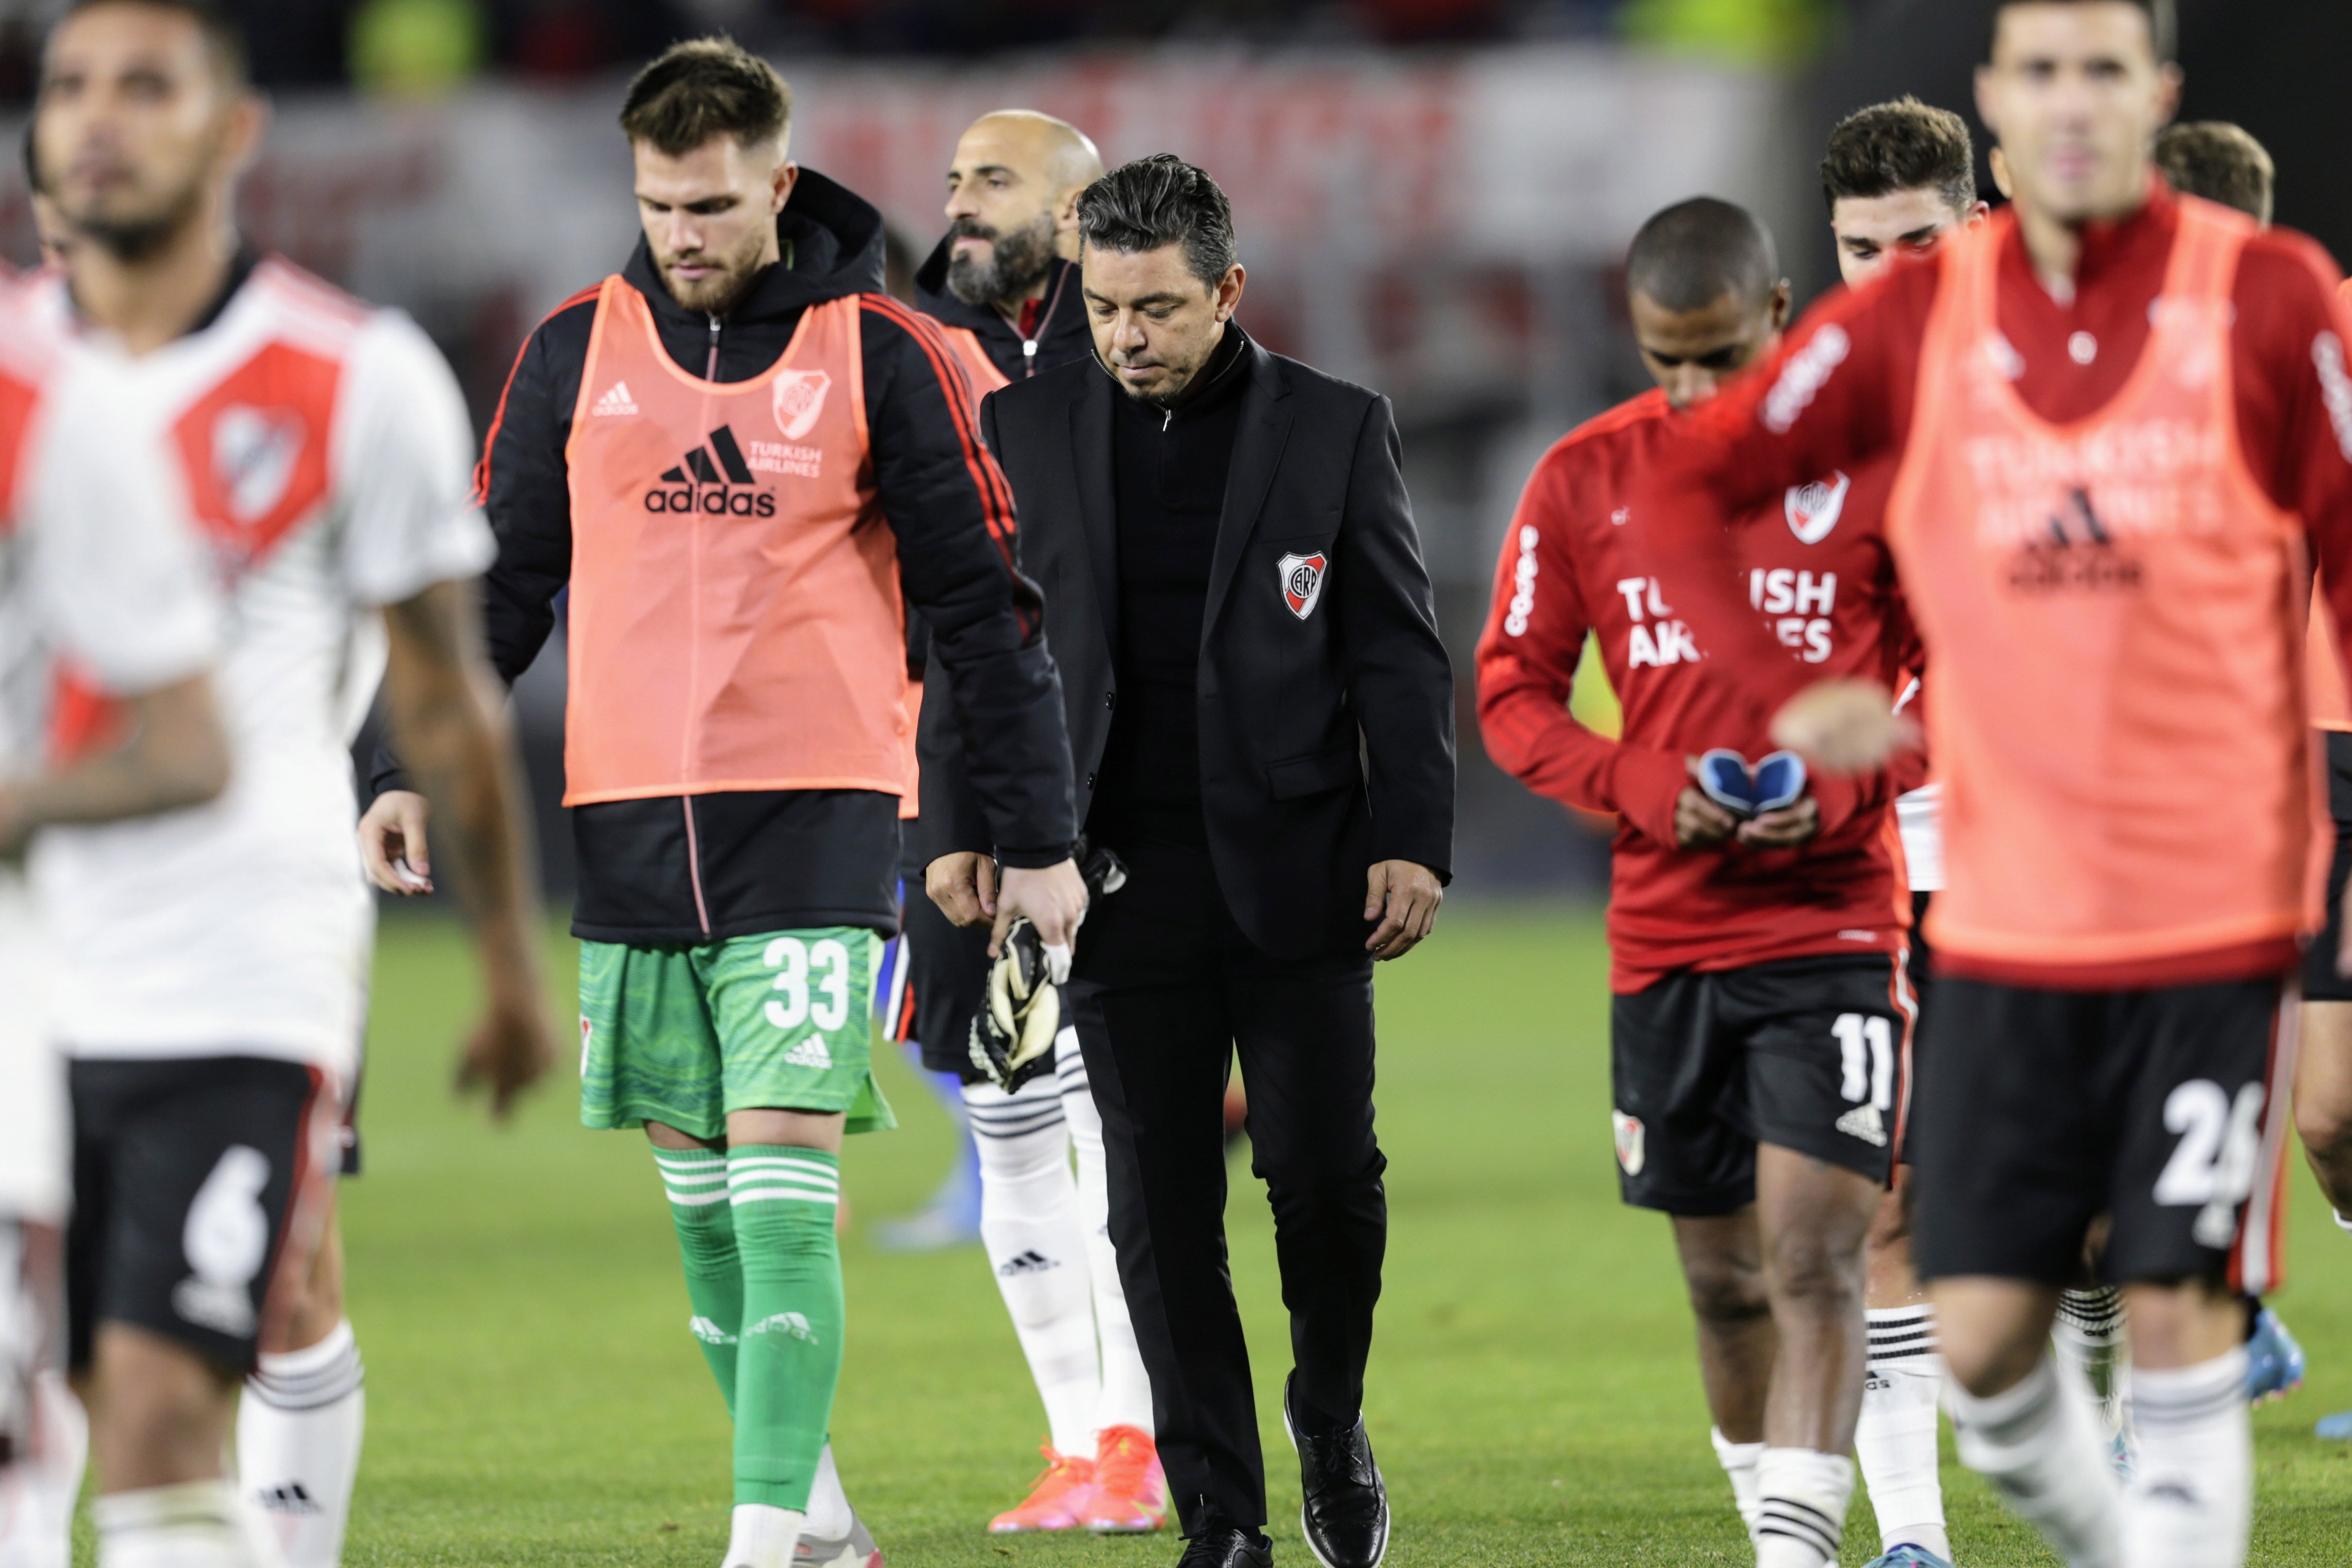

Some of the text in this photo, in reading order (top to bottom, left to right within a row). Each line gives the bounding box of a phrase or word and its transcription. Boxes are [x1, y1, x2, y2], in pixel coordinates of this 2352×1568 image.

[746, 457, 820, 478] AIRLINES
[749, 441, 823, 463] TURKISH
[645, 484, 776, 516] adidas
[763, 936, 850, 1031] 33
[1830, 1013, 1894, 1111] 11
[2151, 1078, 2264, 1207] 26
[181, 1144, 272, 1293] 6
